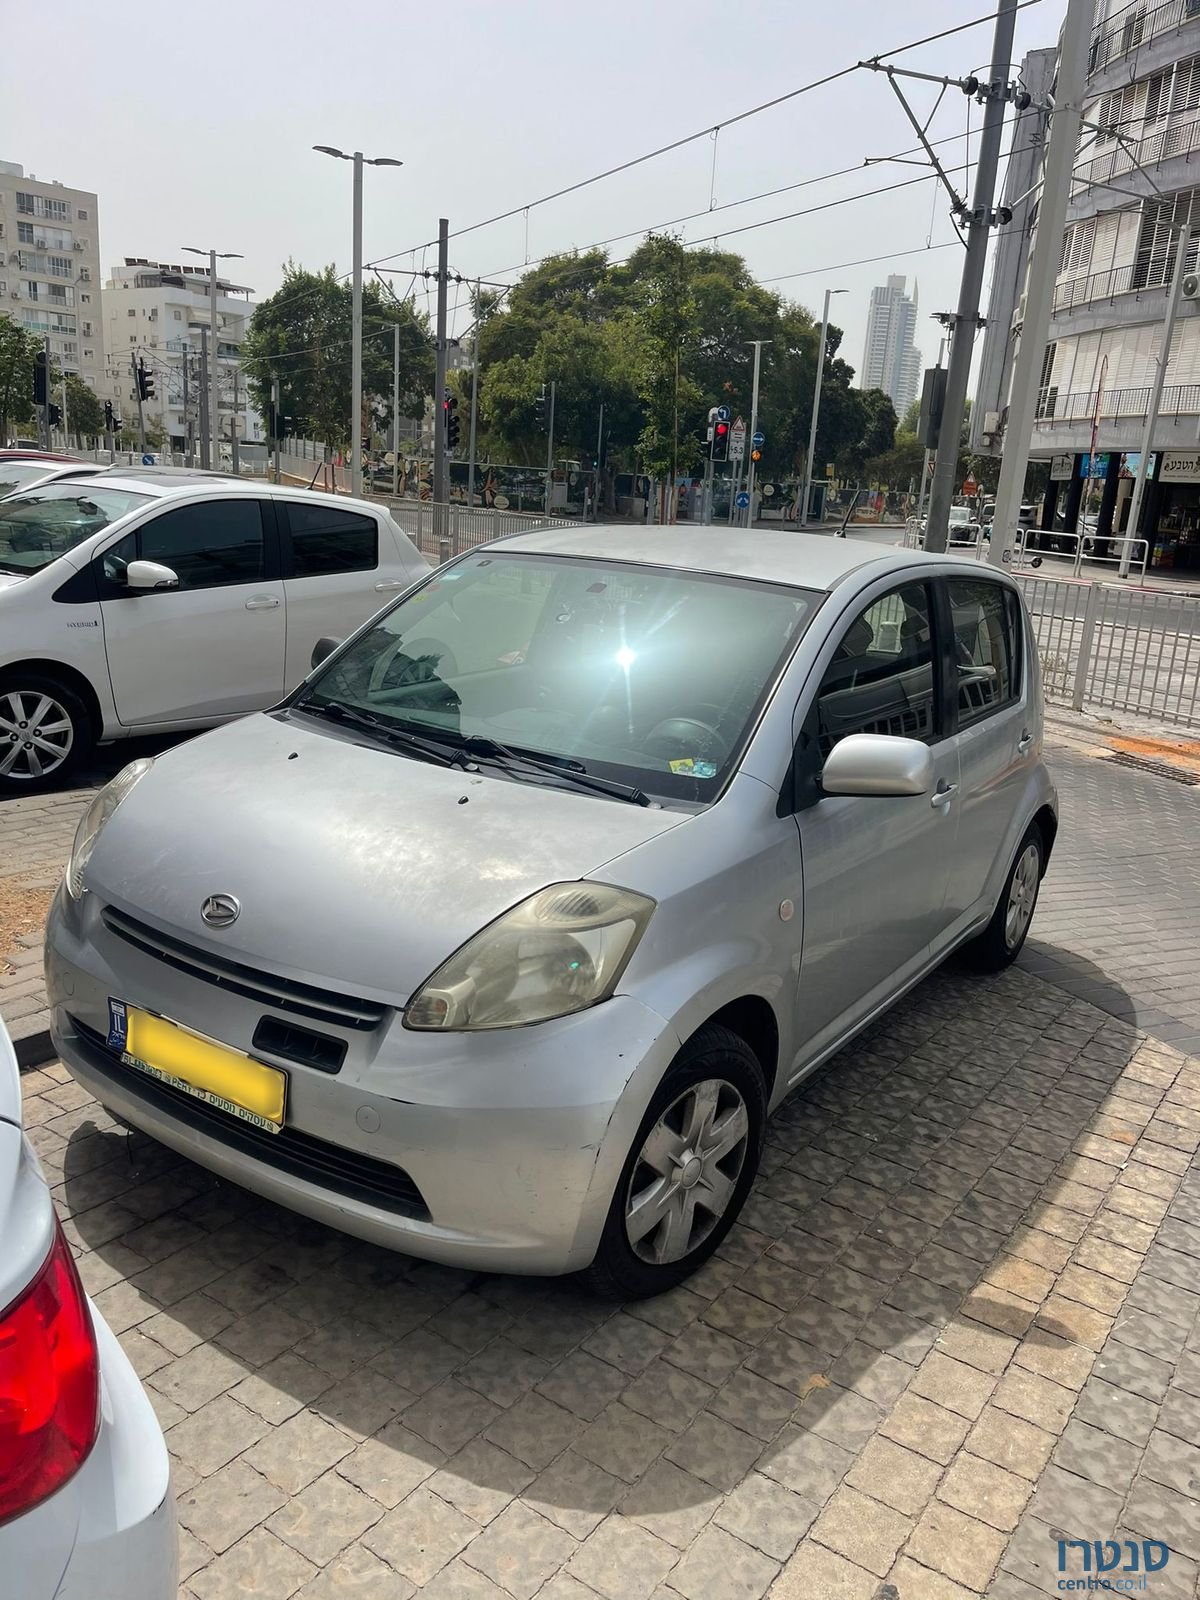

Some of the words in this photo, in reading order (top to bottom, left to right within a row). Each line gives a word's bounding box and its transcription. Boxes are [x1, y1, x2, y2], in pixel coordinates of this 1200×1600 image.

[1169, 460, 1194, 471] הטבע
[113, 1013, 125, 1034] IL
[209, 1094, 236, 1115] נוסעים
[238, 1108, 266, 1128] עסקים
